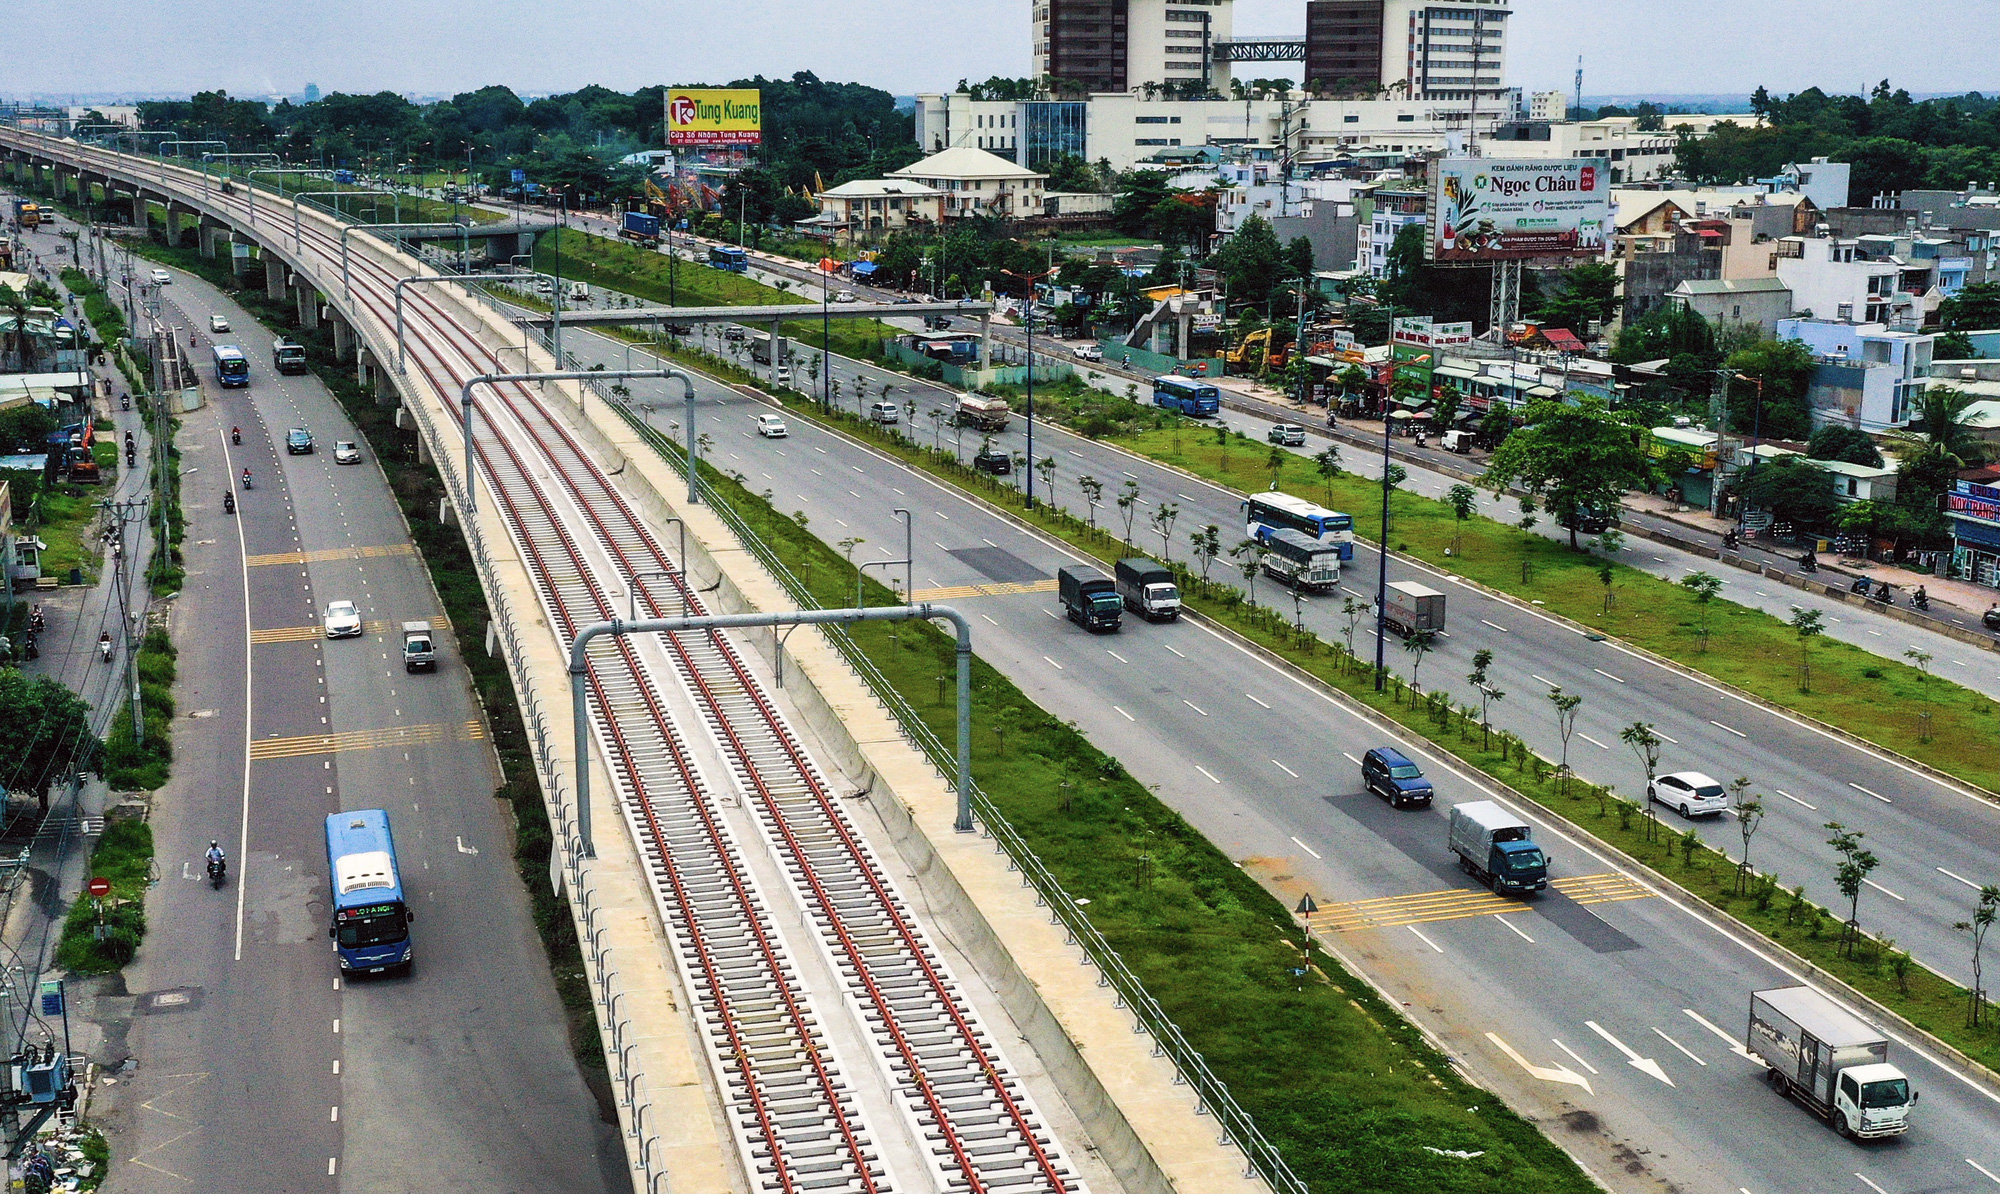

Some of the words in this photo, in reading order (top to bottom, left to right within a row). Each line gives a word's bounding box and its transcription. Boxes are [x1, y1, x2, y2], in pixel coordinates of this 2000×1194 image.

[694, 100, 721, 124] Tung
[724, 100, 758, 124] Kuang
[1490, 176, 1530, 197] Ngọc
[1535, 176, 1576, 192] Châu
[1970, 498, 1996, 520] TRANG
